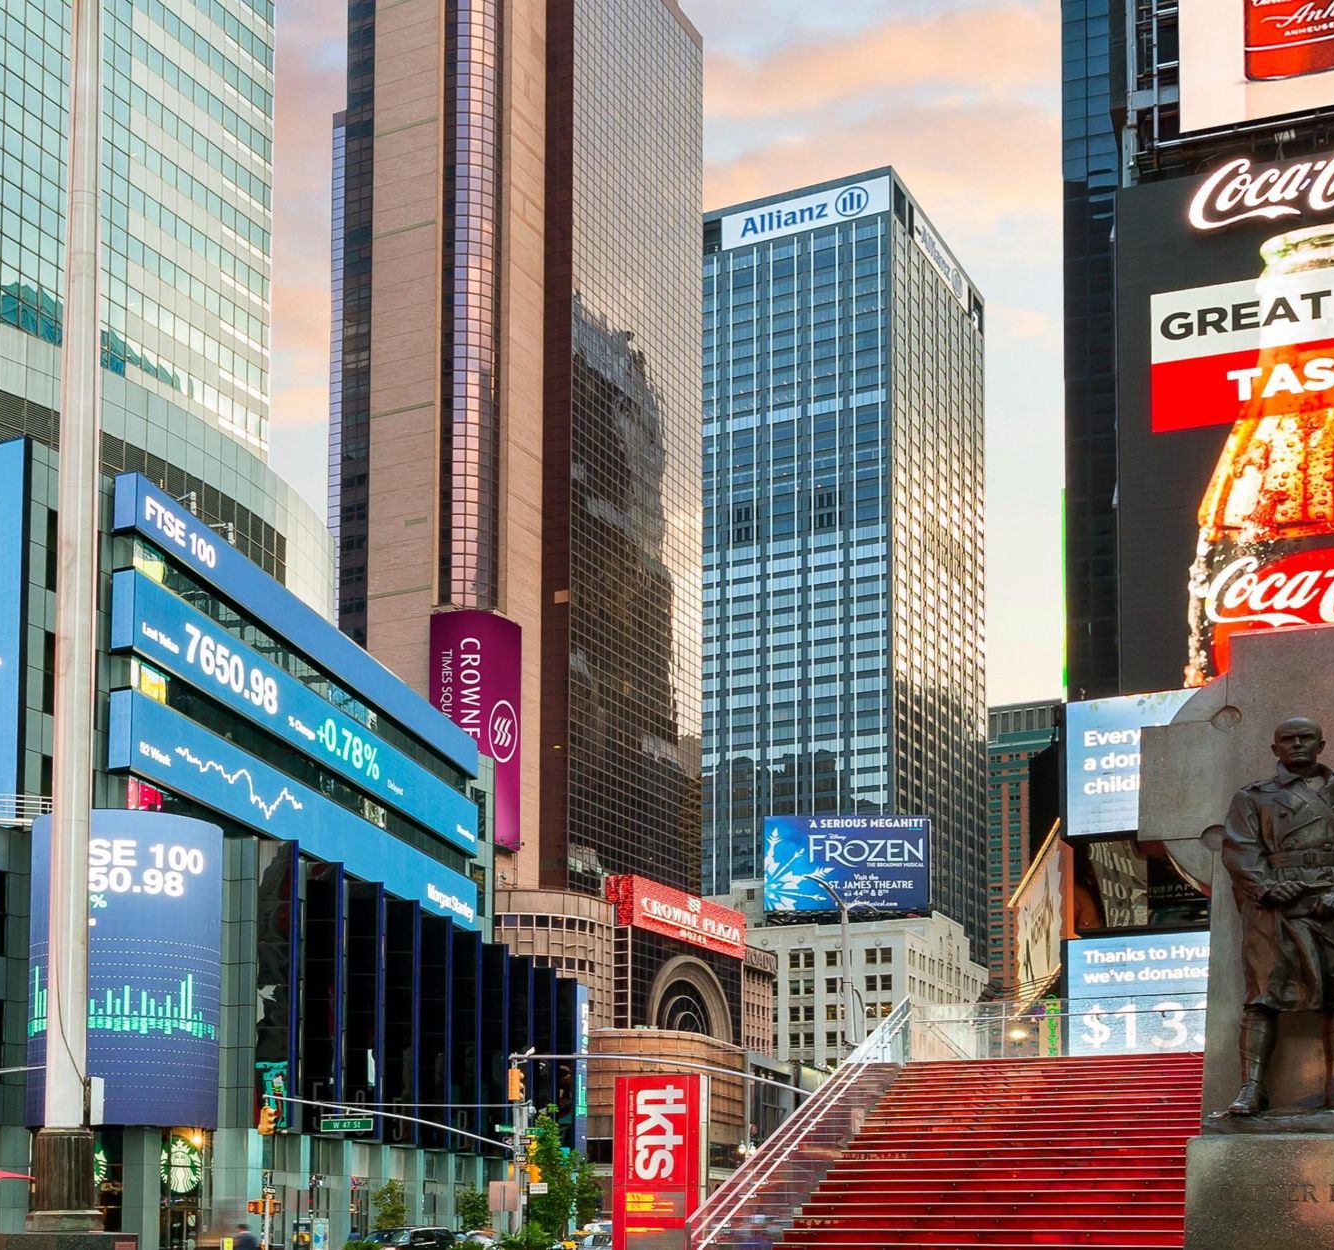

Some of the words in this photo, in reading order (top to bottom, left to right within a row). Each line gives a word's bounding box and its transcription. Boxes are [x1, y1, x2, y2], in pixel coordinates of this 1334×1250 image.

[740, 200, 829, 238] Allianz
[1160, 288, 1332, 341] GREAT
[145, 495, 186, 548] FTSE
[189, 532, 216, 569] 100
[184, 621, 279, 716] 7650.98
[441, 648, 453, 684] TIMES
[460, 637, 481, 741] CROWNE
[316, 718, 380, 781] +0.78%
[1083, 757, 1097, 772] a
[820, 818, 867, 829] SERIOUS
[149, 842, 204, 875] 100
[807, 834, 924, 868] FROZEN
[829, 880, 841, 889] ST.
[842, 880, 872, 889] JAMES
[873, 880, 914, 889] THEATRE
[641, 897, 700, 929] CROWNE
[702, 917, 741, 942] PLAZA
[1083, 950, 1145, 965] Thanks
[1147, 948, 1167, 960] to
[1083, 970, 1135, 984] we've
[332, 1121, 340, 1129] W
[342, 1121, 351, 1129] 47
[353, 1120, 361, 1129] St
[635, 1084, 687, 1181] tkts
